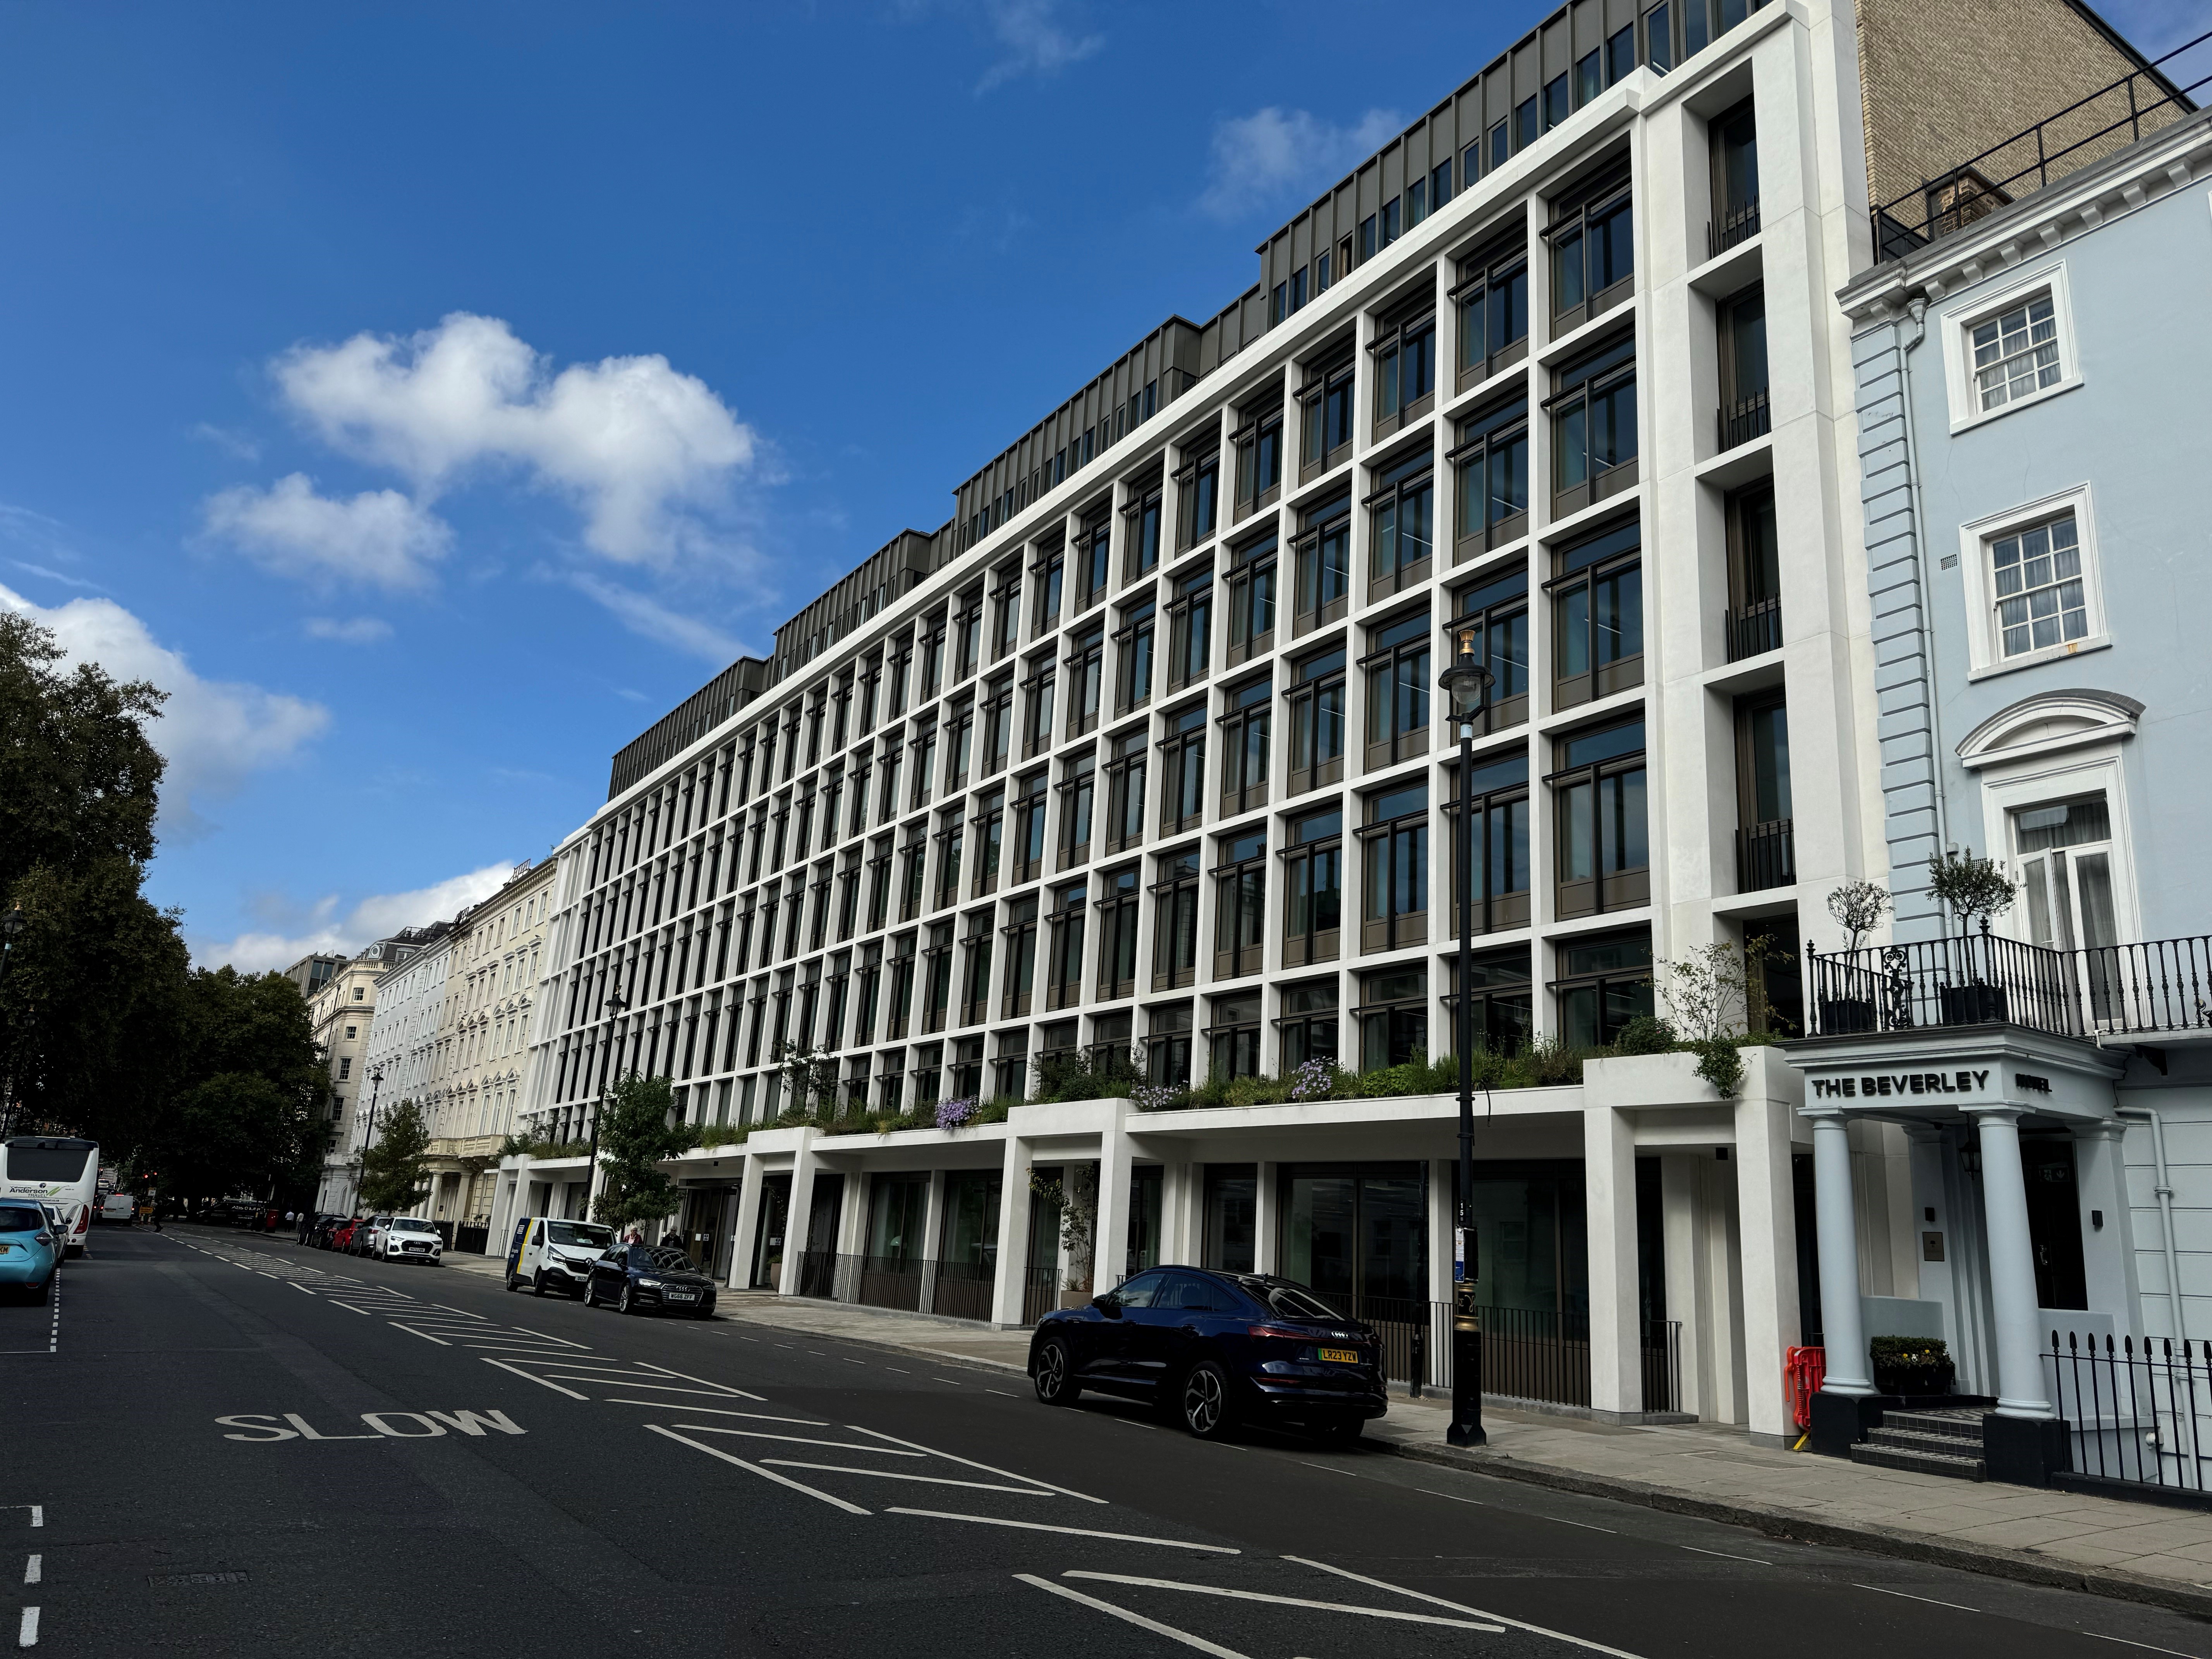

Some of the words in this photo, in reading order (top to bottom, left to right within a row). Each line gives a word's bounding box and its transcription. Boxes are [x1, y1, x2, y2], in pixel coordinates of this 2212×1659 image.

[1812, 1078, 1855, 1097] THE
[1861, 1070, 1989, 1095] BEVERLEY
[1323, 1350, 1341, 1360] LR23
[214, 1410, 527, 1441] SLOW
